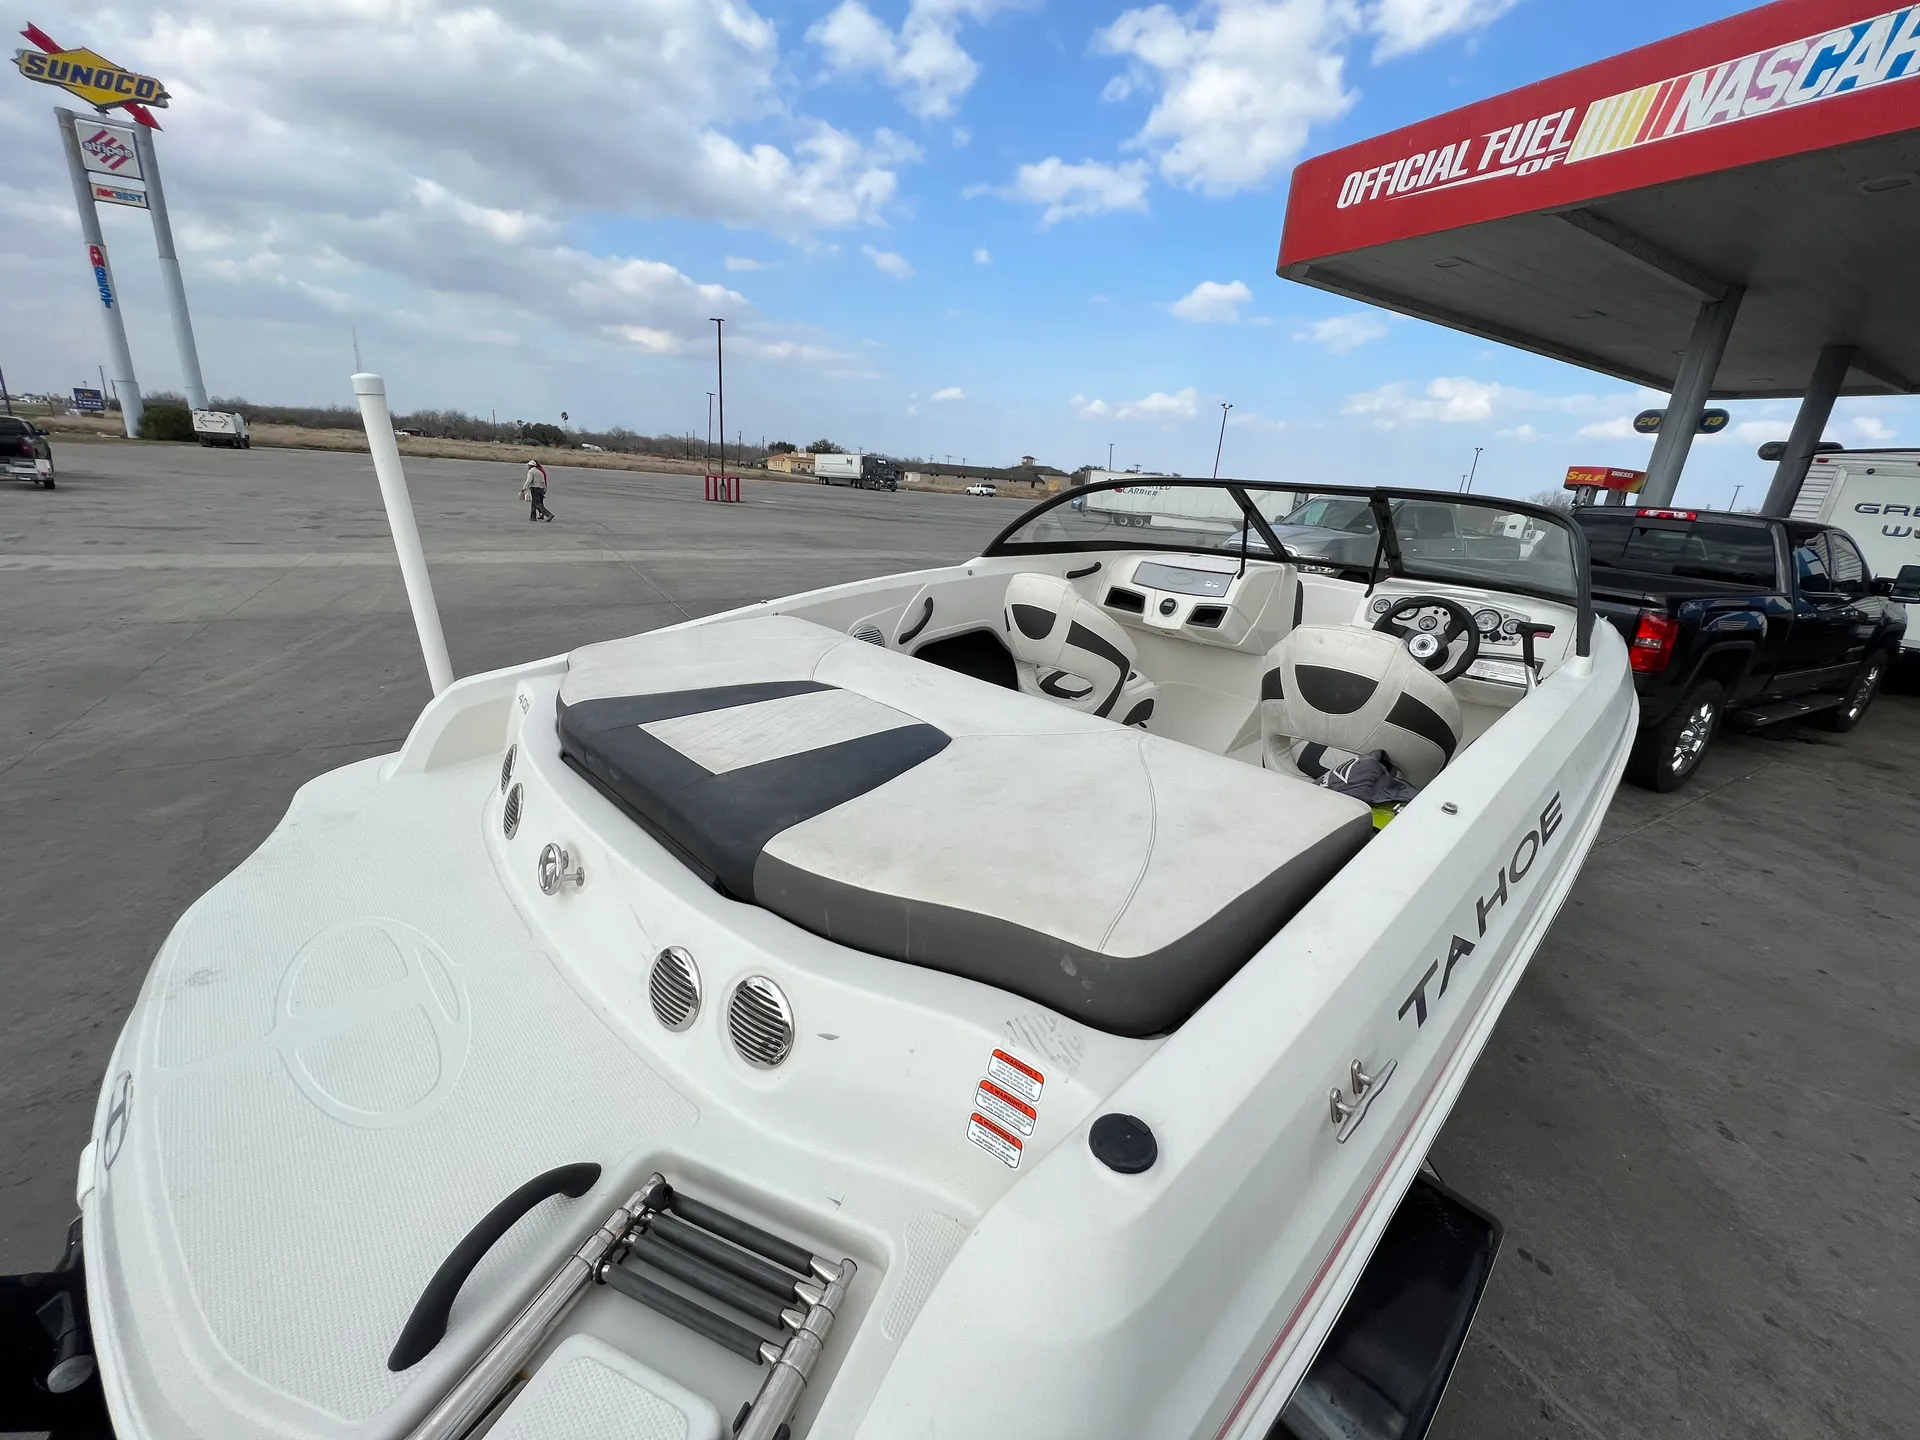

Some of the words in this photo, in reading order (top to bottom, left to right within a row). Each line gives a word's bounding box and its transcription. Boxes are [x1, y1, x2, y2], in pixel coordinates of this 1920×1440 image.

[25, 54, 156, 99] SUNOCO
[83, 141, 134, 159] stripes
[1336, 138, 1472, 209] OFFICIAL
[1477, 107, 1576, 171] FUEL
[1515, 152, 1568, 177] OF
[1637, 417, 1660, 426] 20
[1704, 417, 1723, 426] 19
[1611, 471, 1634, 479] DIESEL
[1123, 486, 1158, 496] CARRIER
[1398, 790, 1563, 1029] TAHOE
[1004, 1055, 1033, 1076] WARNING
[994, 1088, 1022, 1109] WARNING
[983, 1120, 1011, 1140] WARNING
